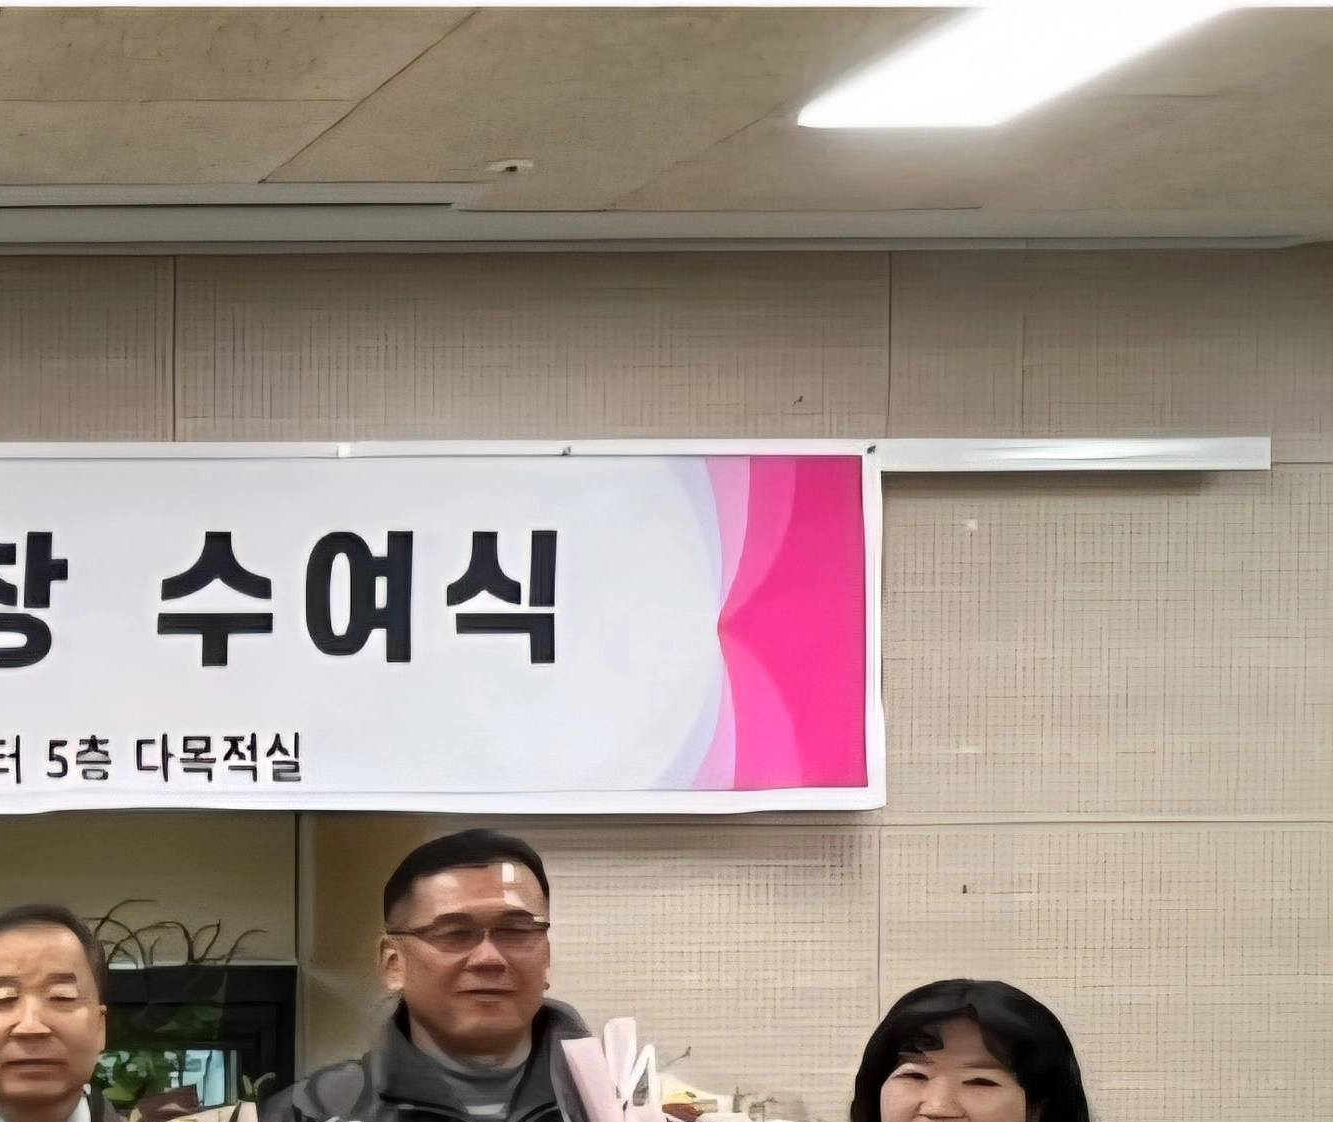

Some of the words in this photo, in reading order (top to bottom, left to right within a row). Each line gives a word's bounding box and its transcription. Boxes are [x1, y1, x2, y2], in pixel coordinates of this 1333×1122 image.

[156, 529, 558, 668] 수여식
[46, 733, 113, 782] 5층
[135, 731, 302, 784] 다목적실
